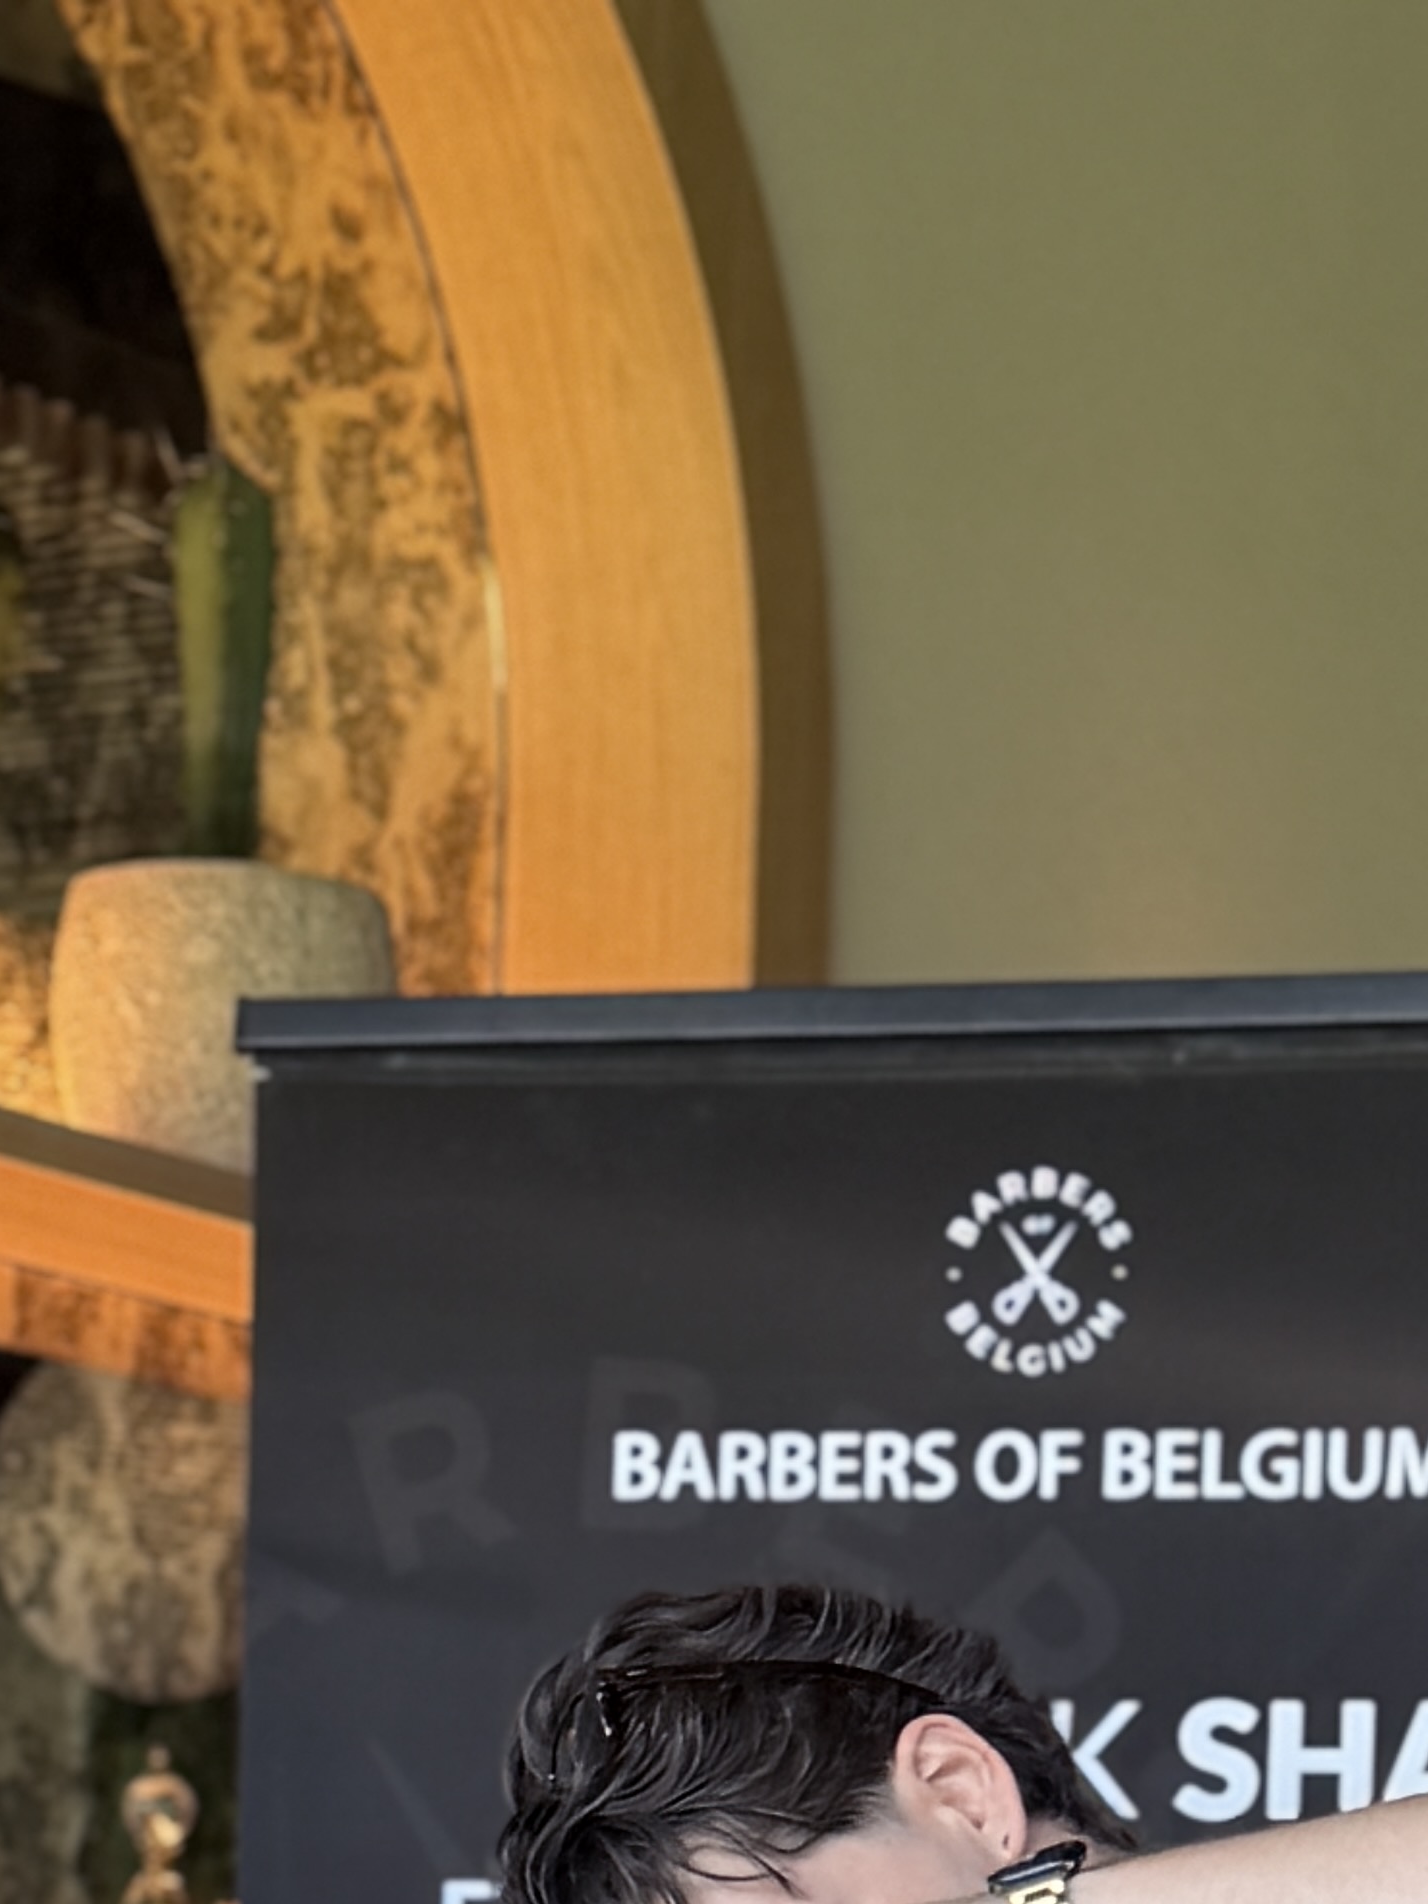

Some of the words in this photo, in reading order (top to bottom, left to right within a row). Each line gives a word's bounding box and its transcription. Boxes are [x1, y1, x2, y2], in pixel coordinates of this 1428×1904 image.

[945, 1165, 1132, 1250] BARBERS
[945, 1299, 1126, 1378] BELGIUM
[611, 1429, 958, 1502] BARBERS
[972, 1428, 1084, 1502] OF
